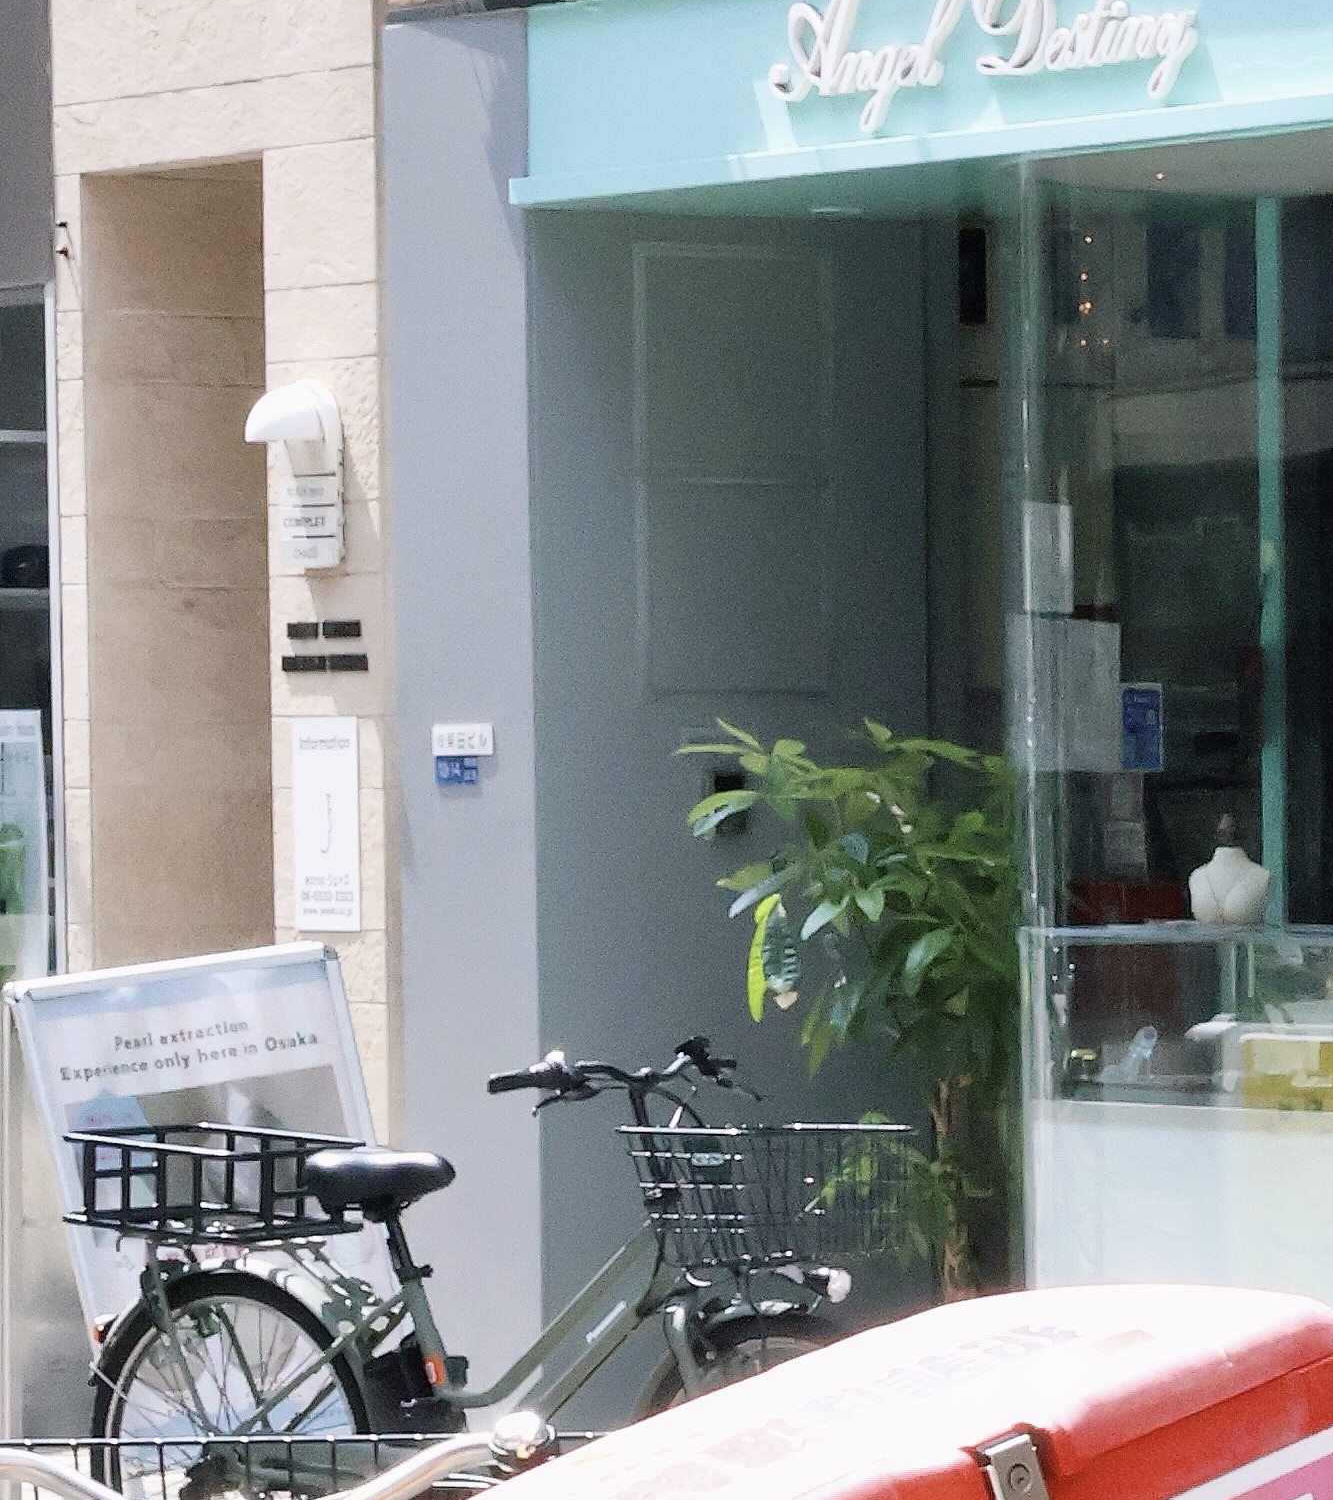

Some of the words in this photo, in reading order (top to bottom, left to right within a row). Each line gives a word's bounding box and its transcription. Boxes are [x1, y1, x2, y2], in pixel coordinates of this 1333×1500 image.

[113, 1033, 153, 1051] Pearl
[159, 1019, 249, 1047] extraction
[60, 1059, 148, 1082] Experience
[154, 1051, 190, 1070] only
[198, 1046, 237, 1063] here
[264, 1031, 318, 1051] Osaka
